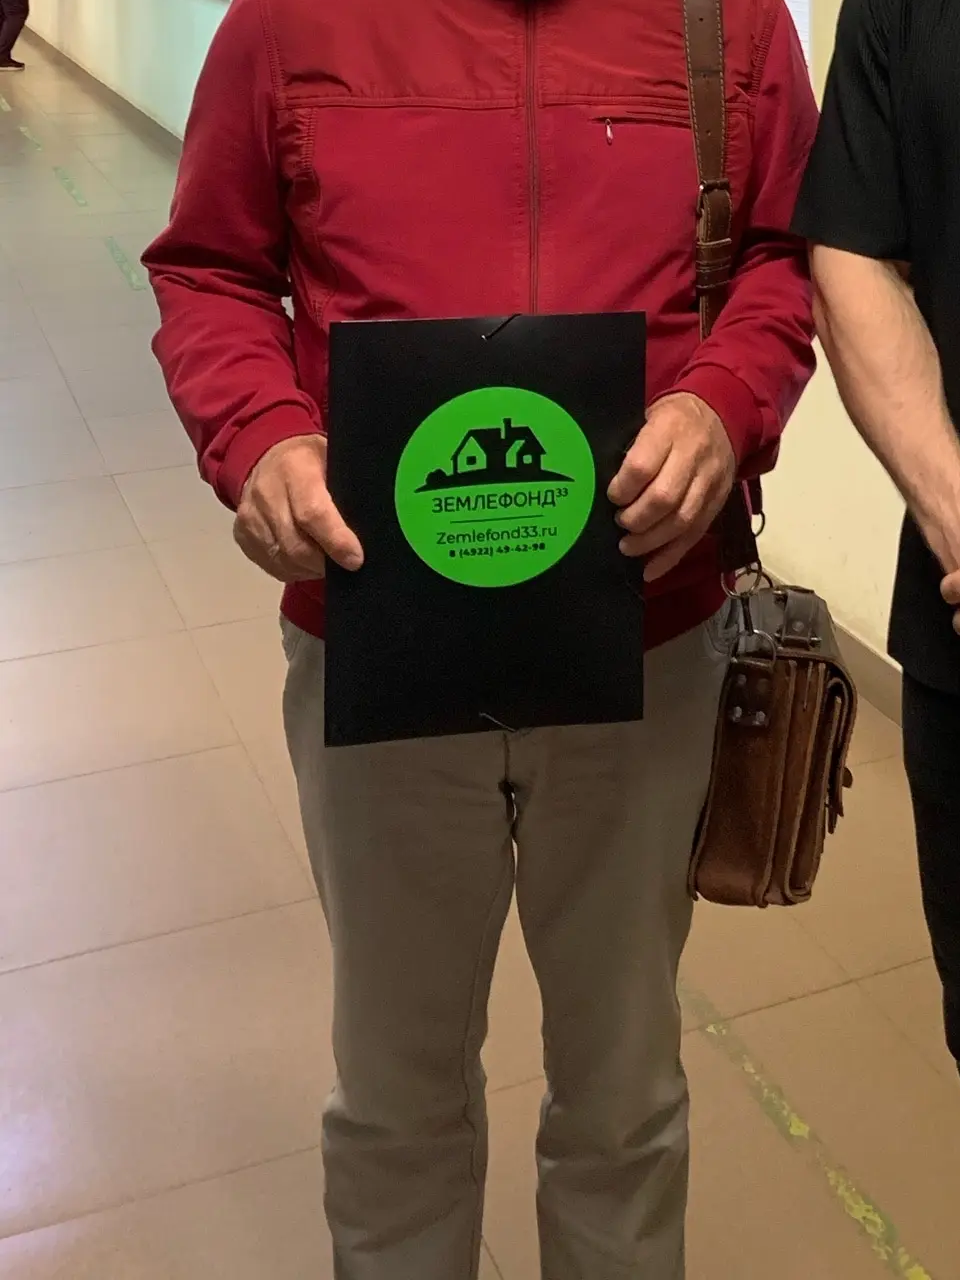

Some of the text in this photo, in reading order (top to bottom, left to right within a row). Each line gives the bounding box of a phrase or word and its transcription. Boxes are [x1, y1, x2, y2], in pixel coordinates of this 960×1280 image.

[436, 525, 558, 545] Zemlefond33.ru
[448, 549, 456, 558] 8
[459, 546, 494, 559] (4922)
